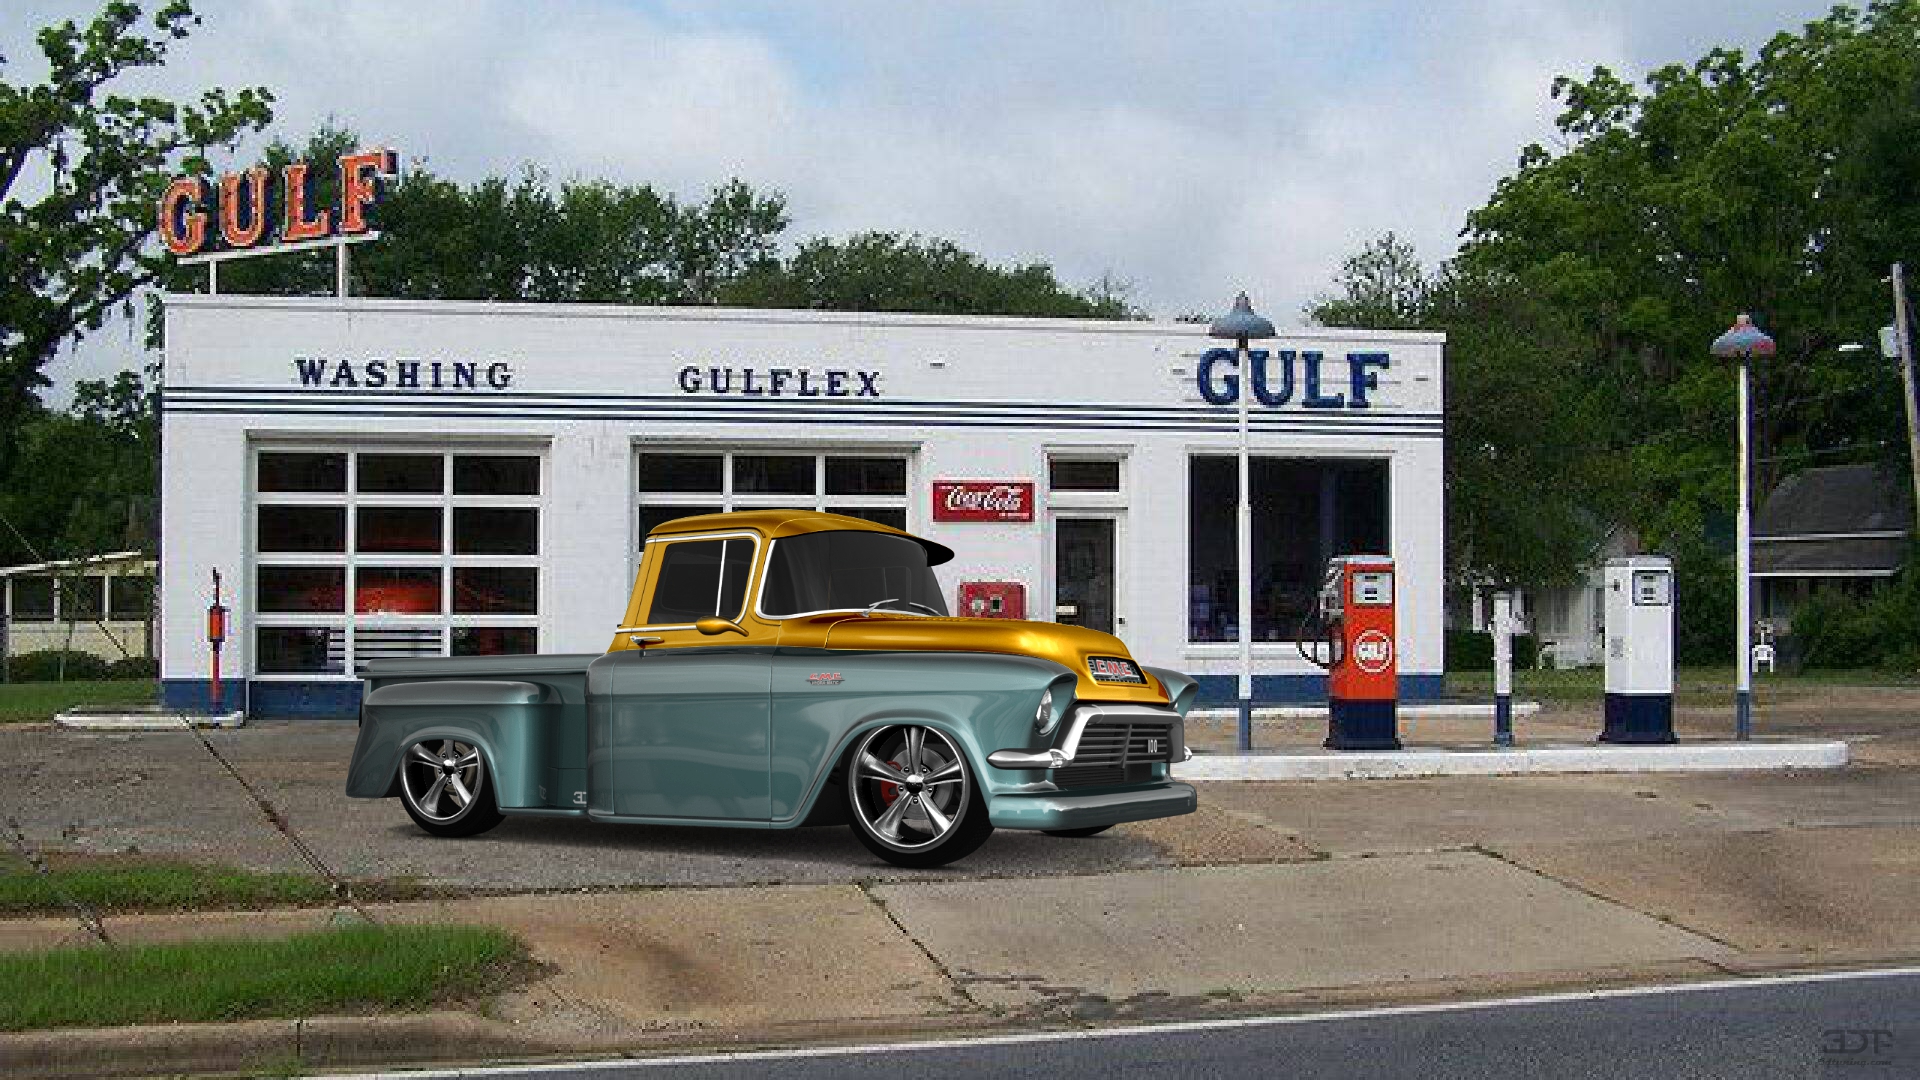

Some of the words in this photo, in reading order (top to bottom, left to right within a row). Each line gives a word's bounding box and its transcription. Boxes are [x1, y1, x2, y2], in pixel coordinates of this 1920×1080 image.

[159, 150, 394, 253] GULF
[294, 359, 511, 389] WASHING
[679, 366, 880, 397] GULFLEX
[1197, 348, 1390, 408] GULF
